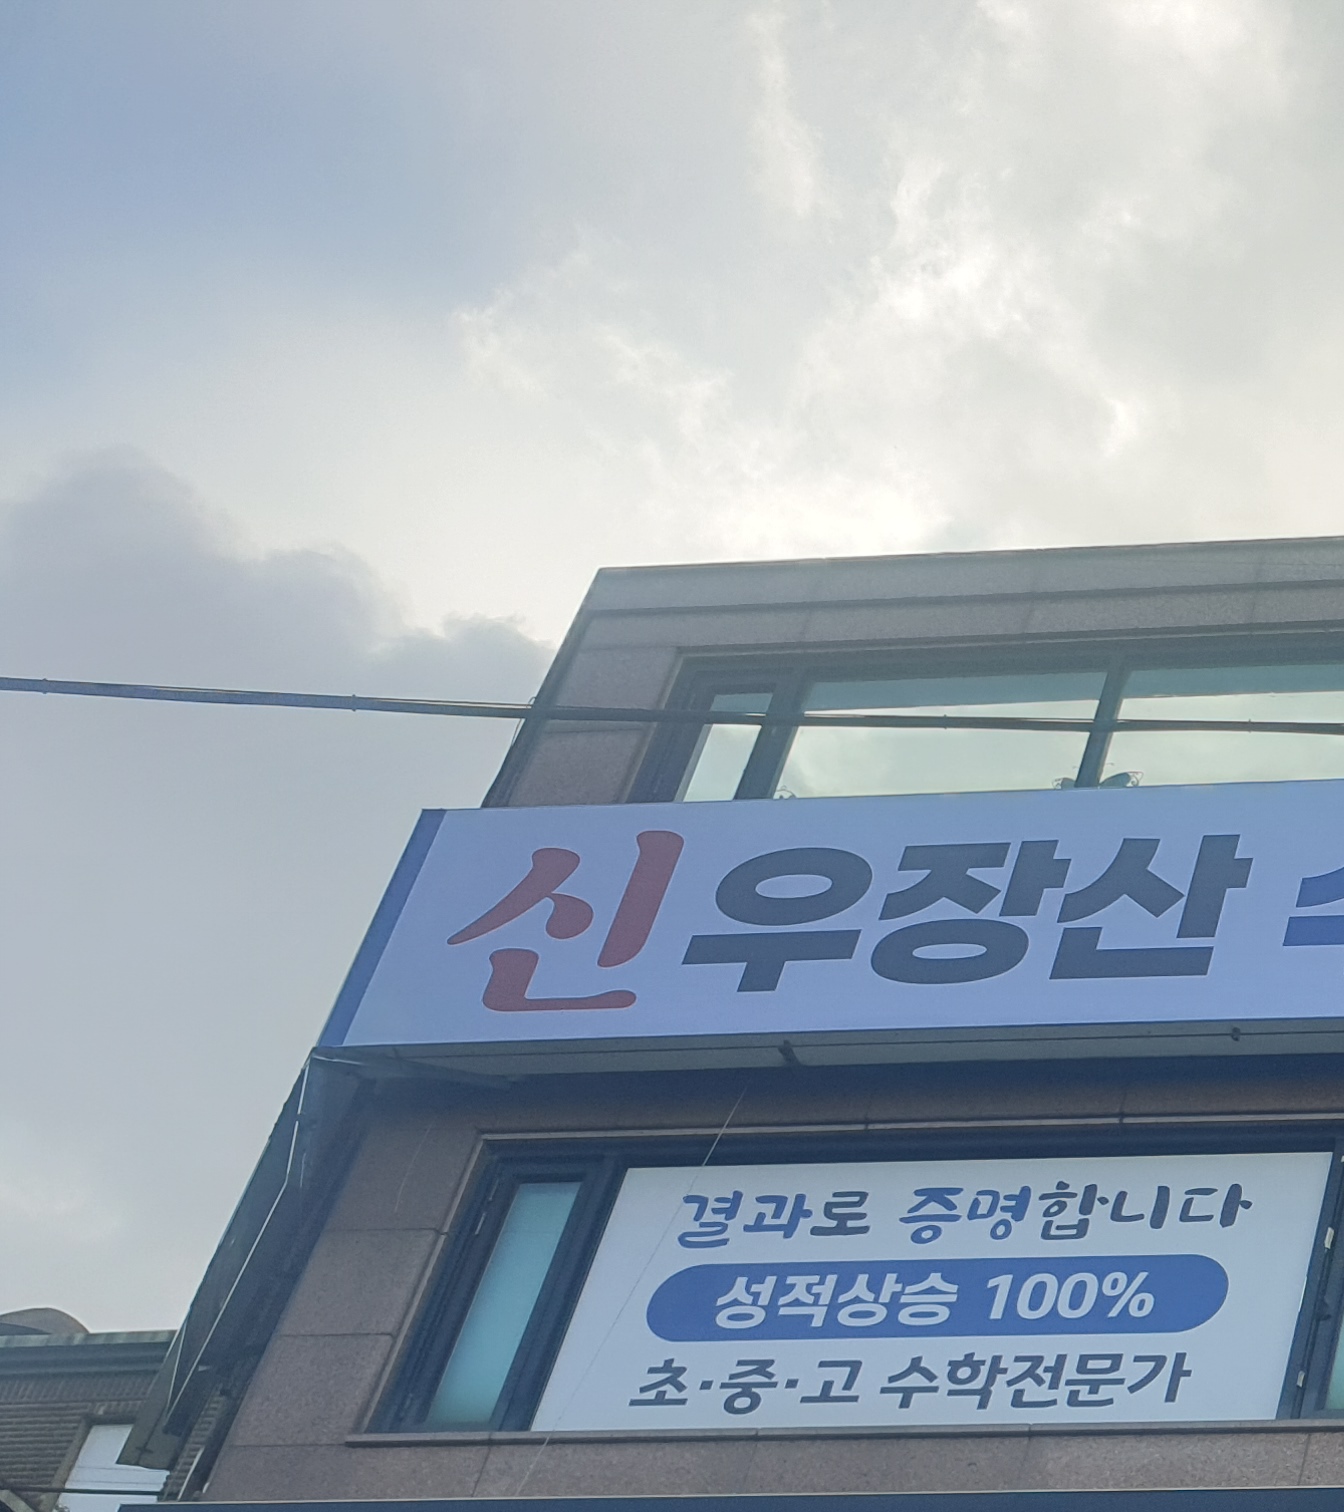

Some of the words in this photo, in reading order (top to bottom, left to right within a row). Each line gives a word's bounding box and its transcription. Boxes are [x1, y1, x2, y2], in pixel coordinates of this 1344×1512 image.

[676, 1188, 871, 1249] 결과로
[898, 1182, 1253, 1246] 증명합니다
[714, 1272, 960, 1331] 성적상승
[986, 1271, 1156, 1321] 100%
[880, 1352, 1193, 1411] 수학전문가
